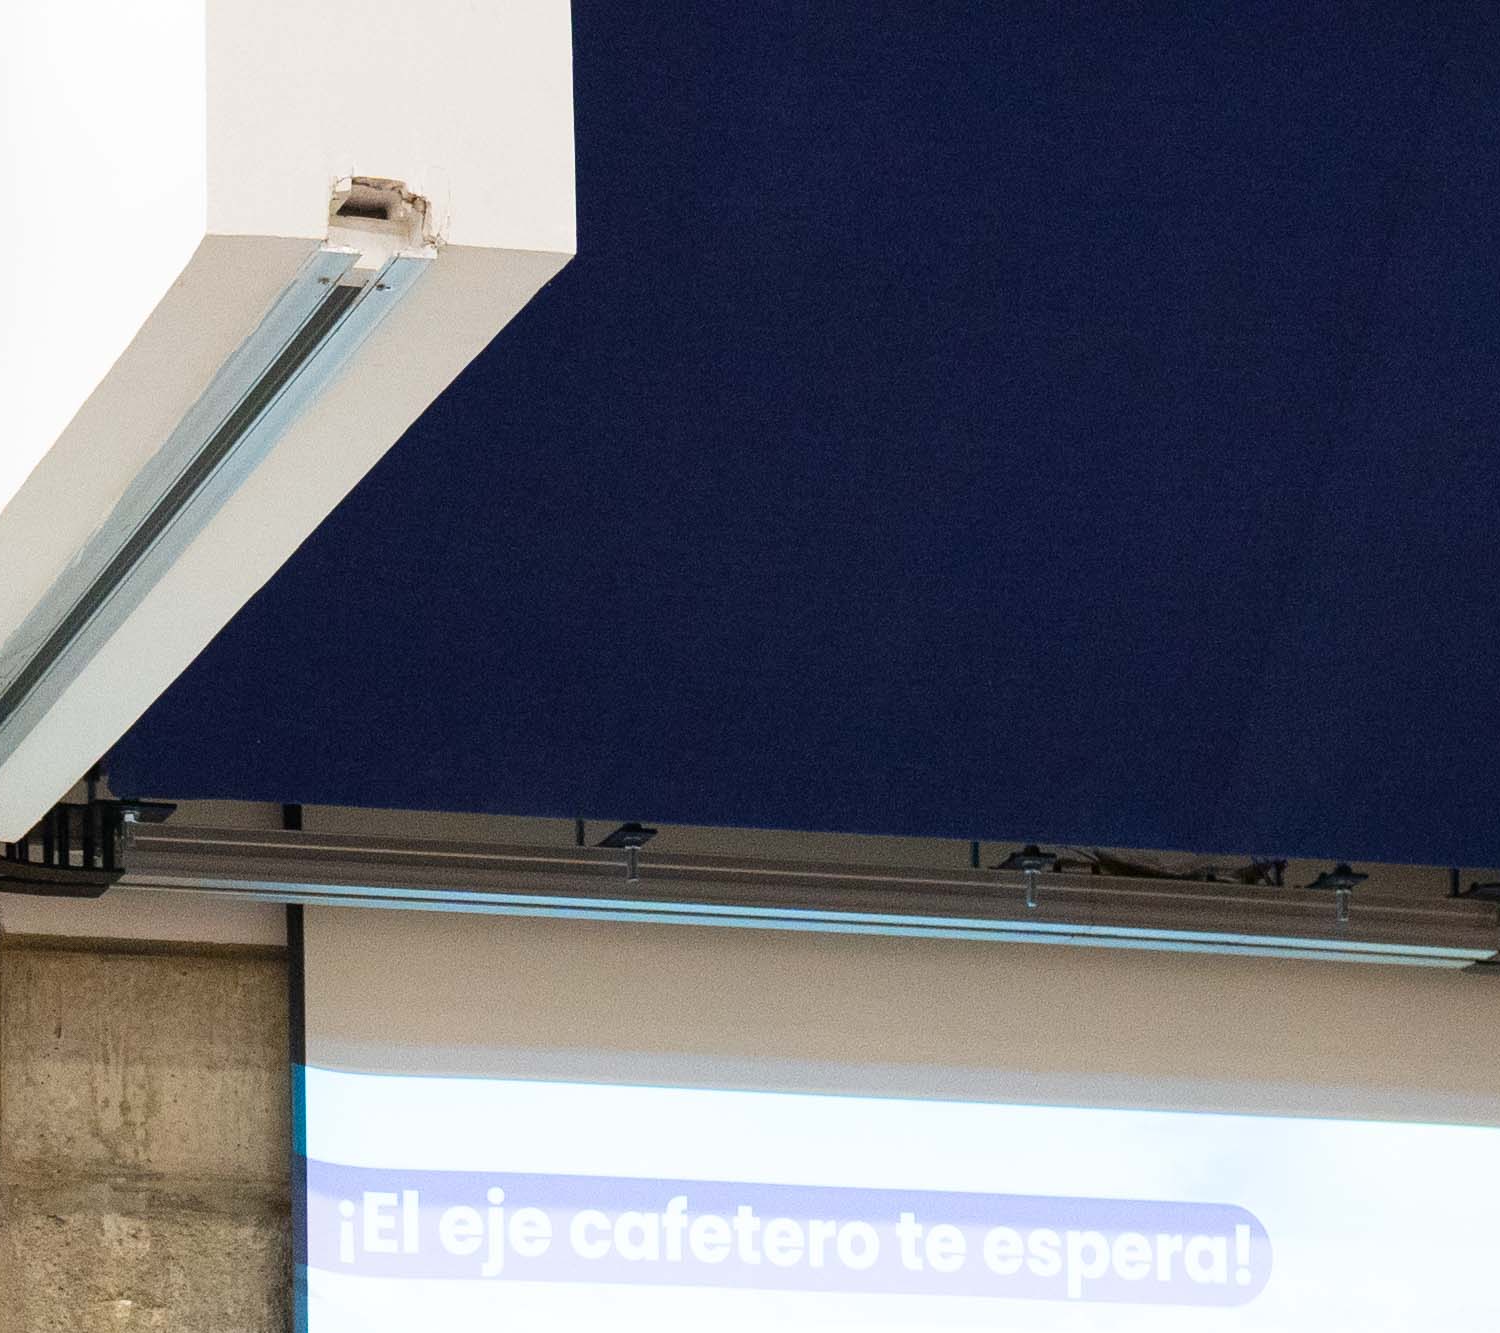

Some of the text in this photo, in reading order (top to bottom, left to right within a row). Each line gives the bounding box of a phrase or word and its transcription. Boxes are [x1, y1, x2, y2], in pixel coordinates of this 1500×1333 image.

[338, 1189, 1252, 1299] ¡El eje cafetero te espera!
